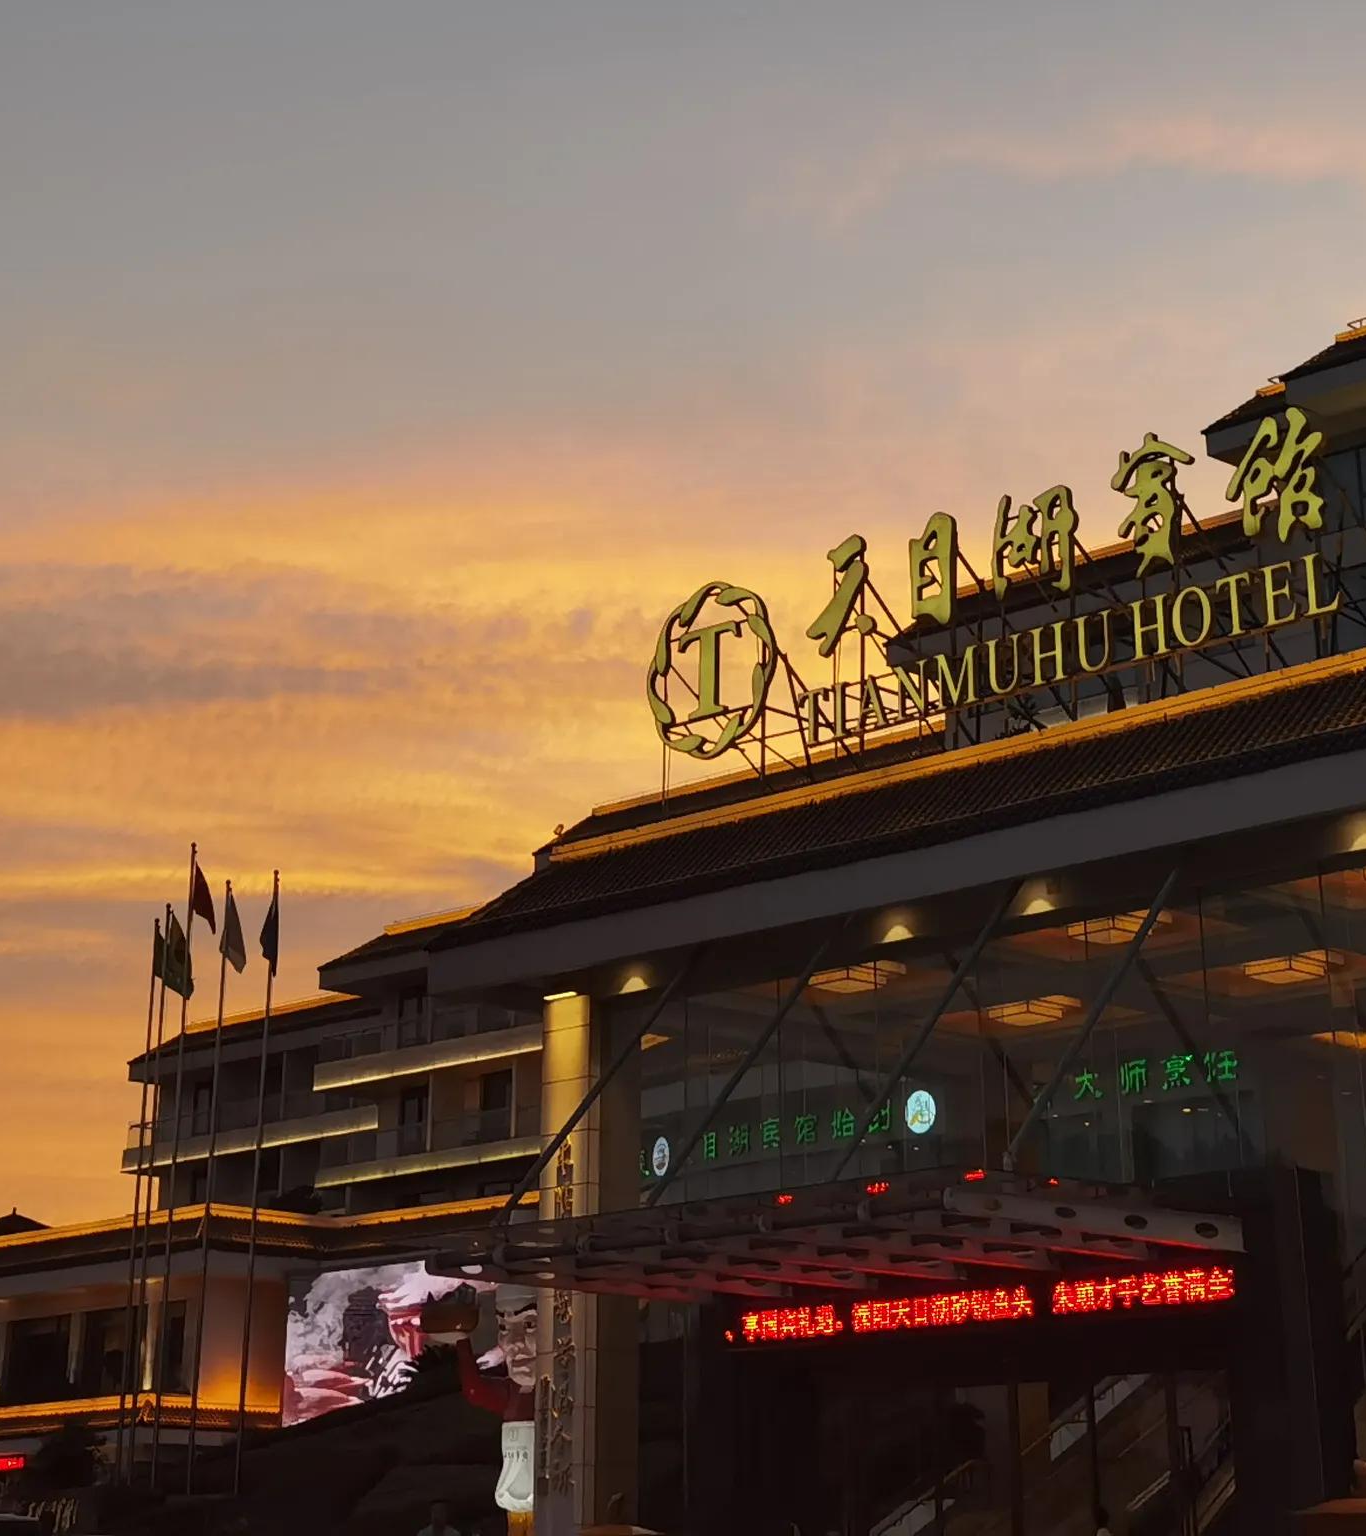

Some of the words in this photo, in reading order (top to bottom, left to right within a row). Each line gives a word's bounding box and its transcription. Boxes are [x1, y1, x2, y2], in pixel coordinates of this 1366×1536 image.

[798, 609, 1112, 745] TIANMUHU
[1130, 552, 1342, 661] HOTEL
[1073, 1050, 1239, 1100] 大师烹饪
